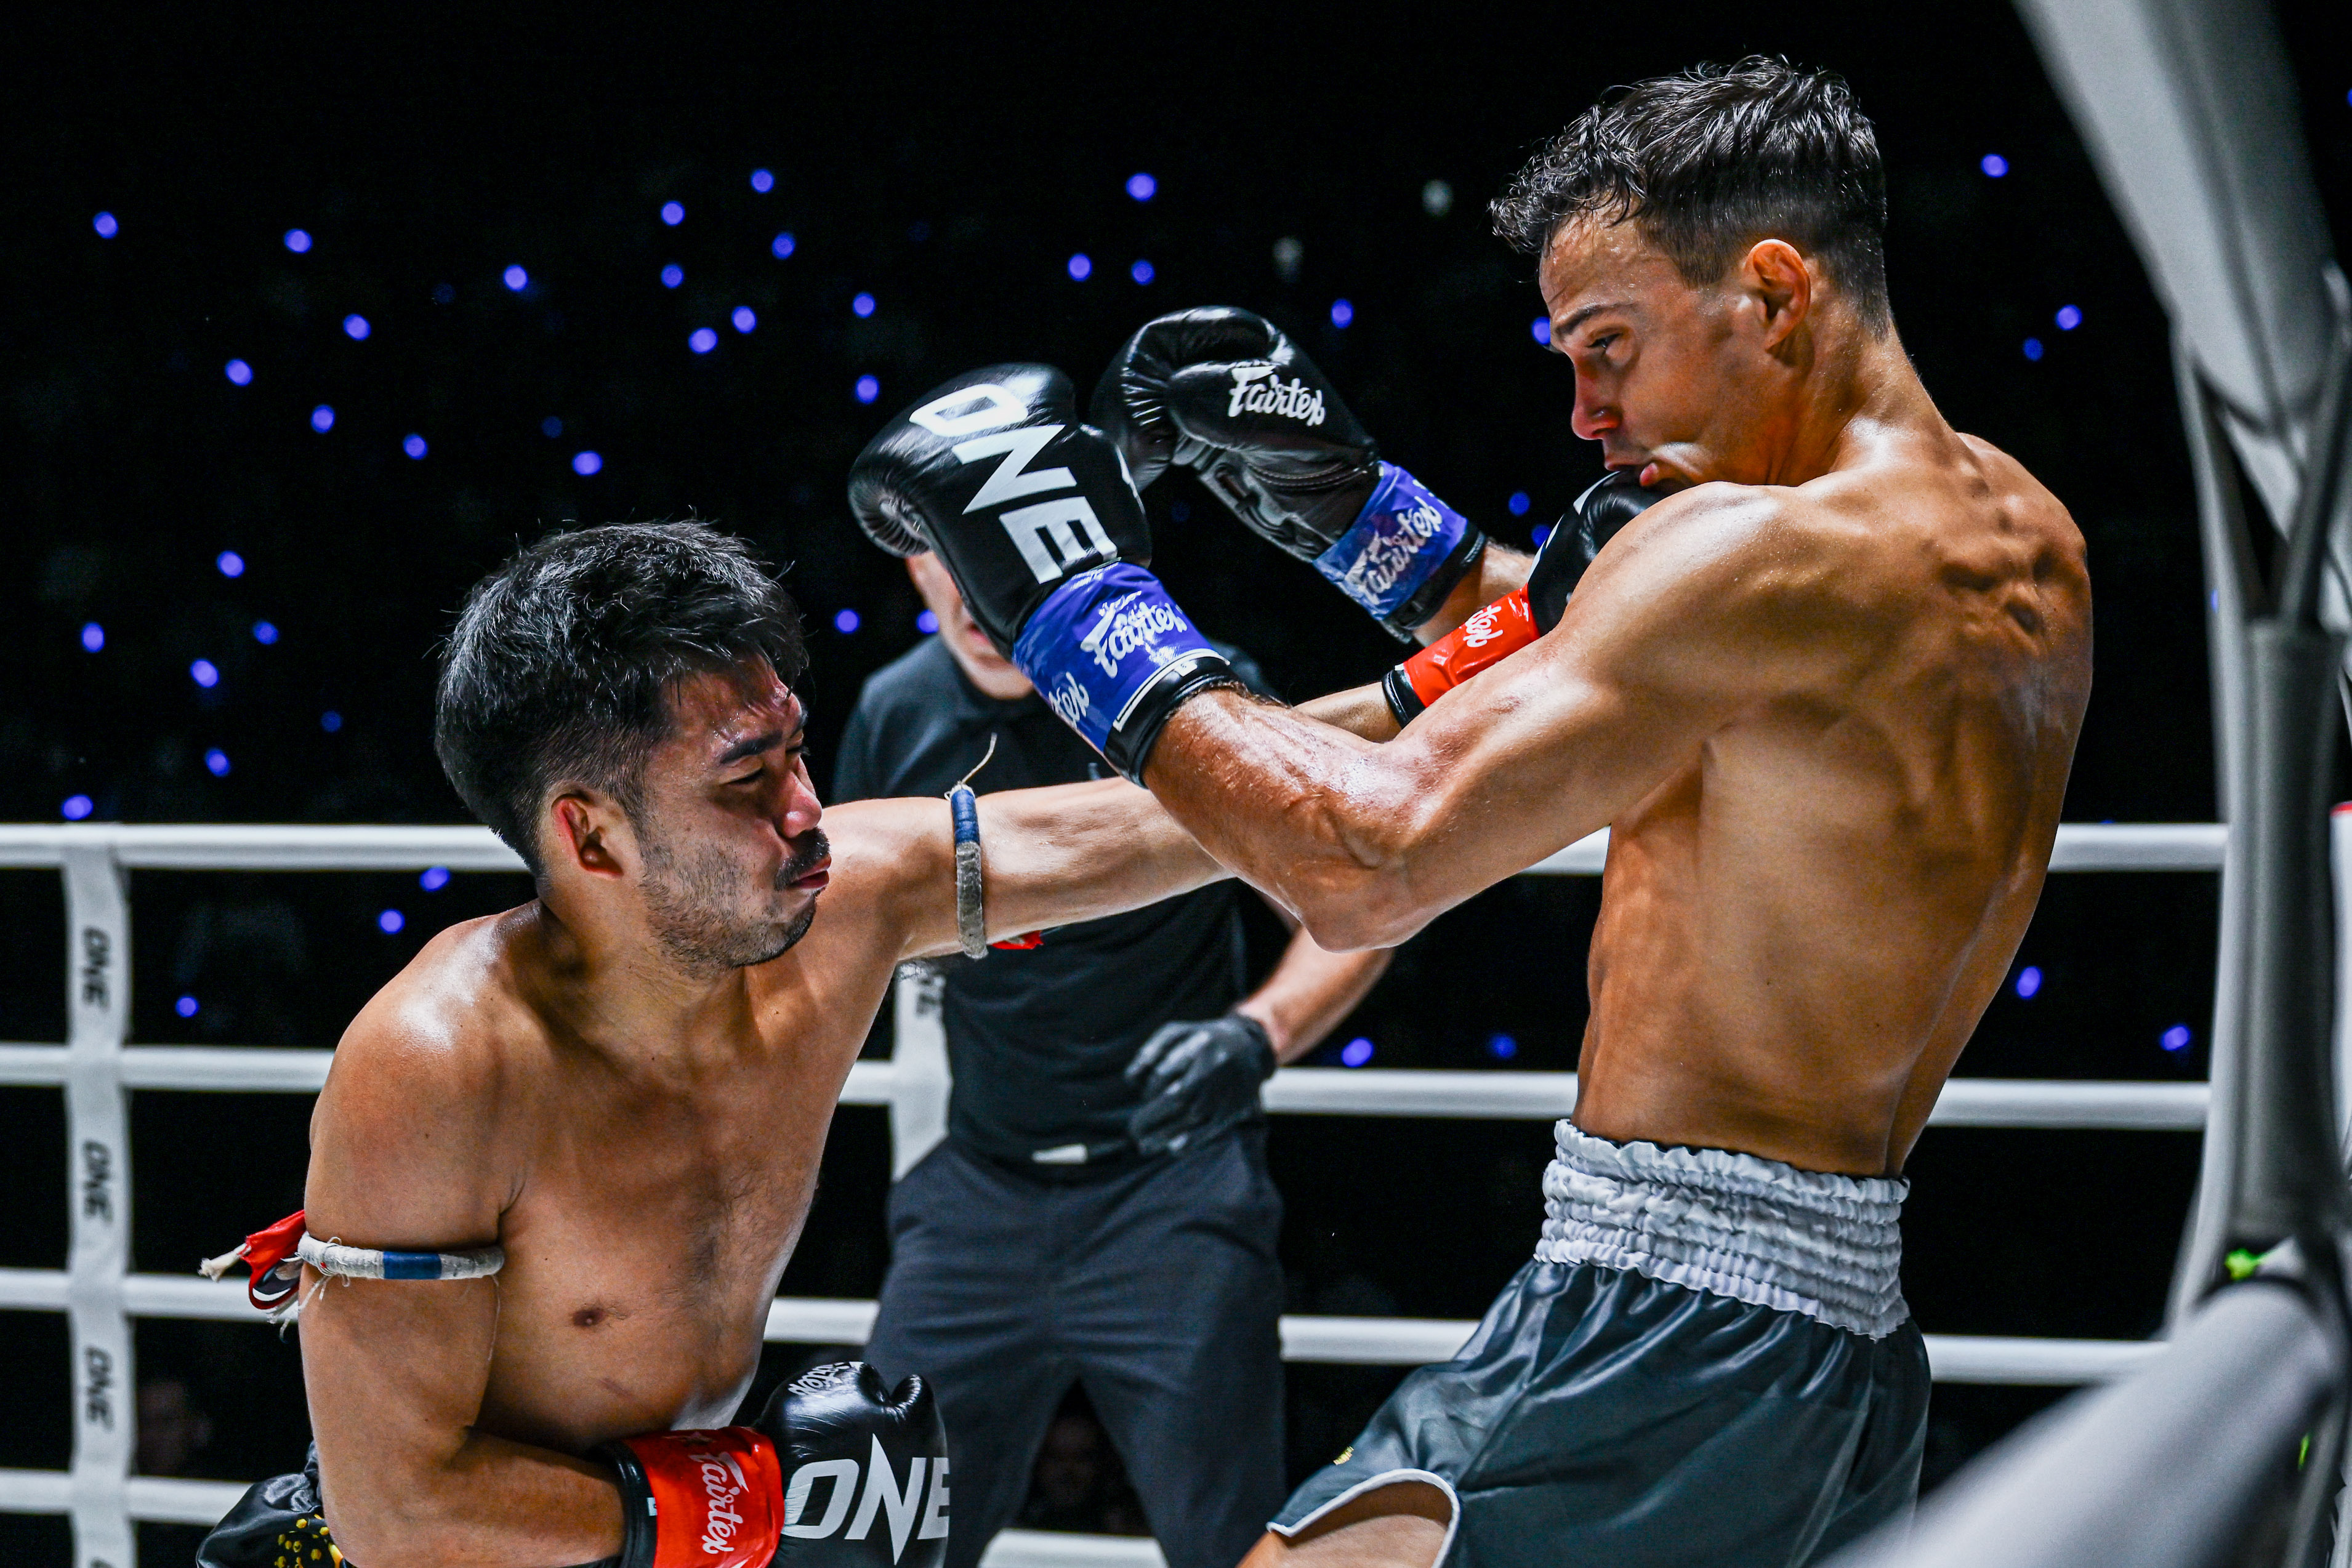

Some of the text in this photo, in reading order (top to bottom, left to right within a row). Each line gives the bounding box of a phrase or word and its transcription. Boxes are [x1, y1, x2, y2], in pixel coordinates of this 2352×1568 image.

[1229, 366, 1326, 426] Fairtex
[909, 384, 1118, 584] ONE
[1344, 496, 1443, 605] Fairtex
[1080, 592, 1188, 678] Fairtex
[83, 926, 111, 1013] ONE
[83, 1141, 113, 1224] ONE
[84, 1346, 115, 1433] ONE
[688, 1451, 749, 1554] Fairtex
[781, 1433, 950, 1566] ONE
